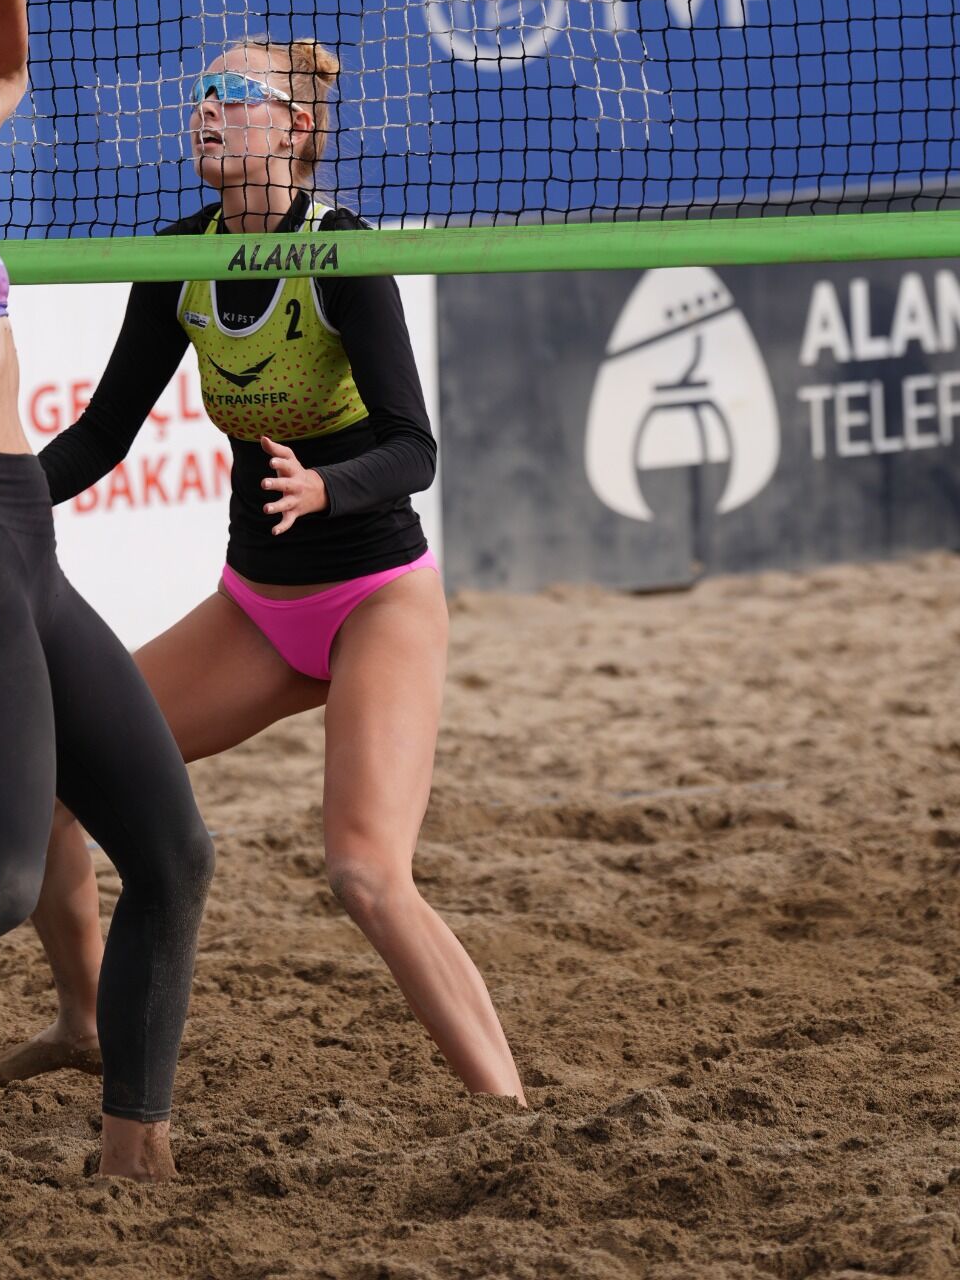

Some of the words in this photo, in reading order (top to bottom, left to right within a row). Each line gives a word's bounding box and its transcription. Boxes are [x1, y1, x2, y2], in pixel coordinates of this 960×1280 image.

[227, 242, 339, 271] ALANYA
[285, 298, 303, 341] 2
[217, 392, 289, 405] TRANSFER
